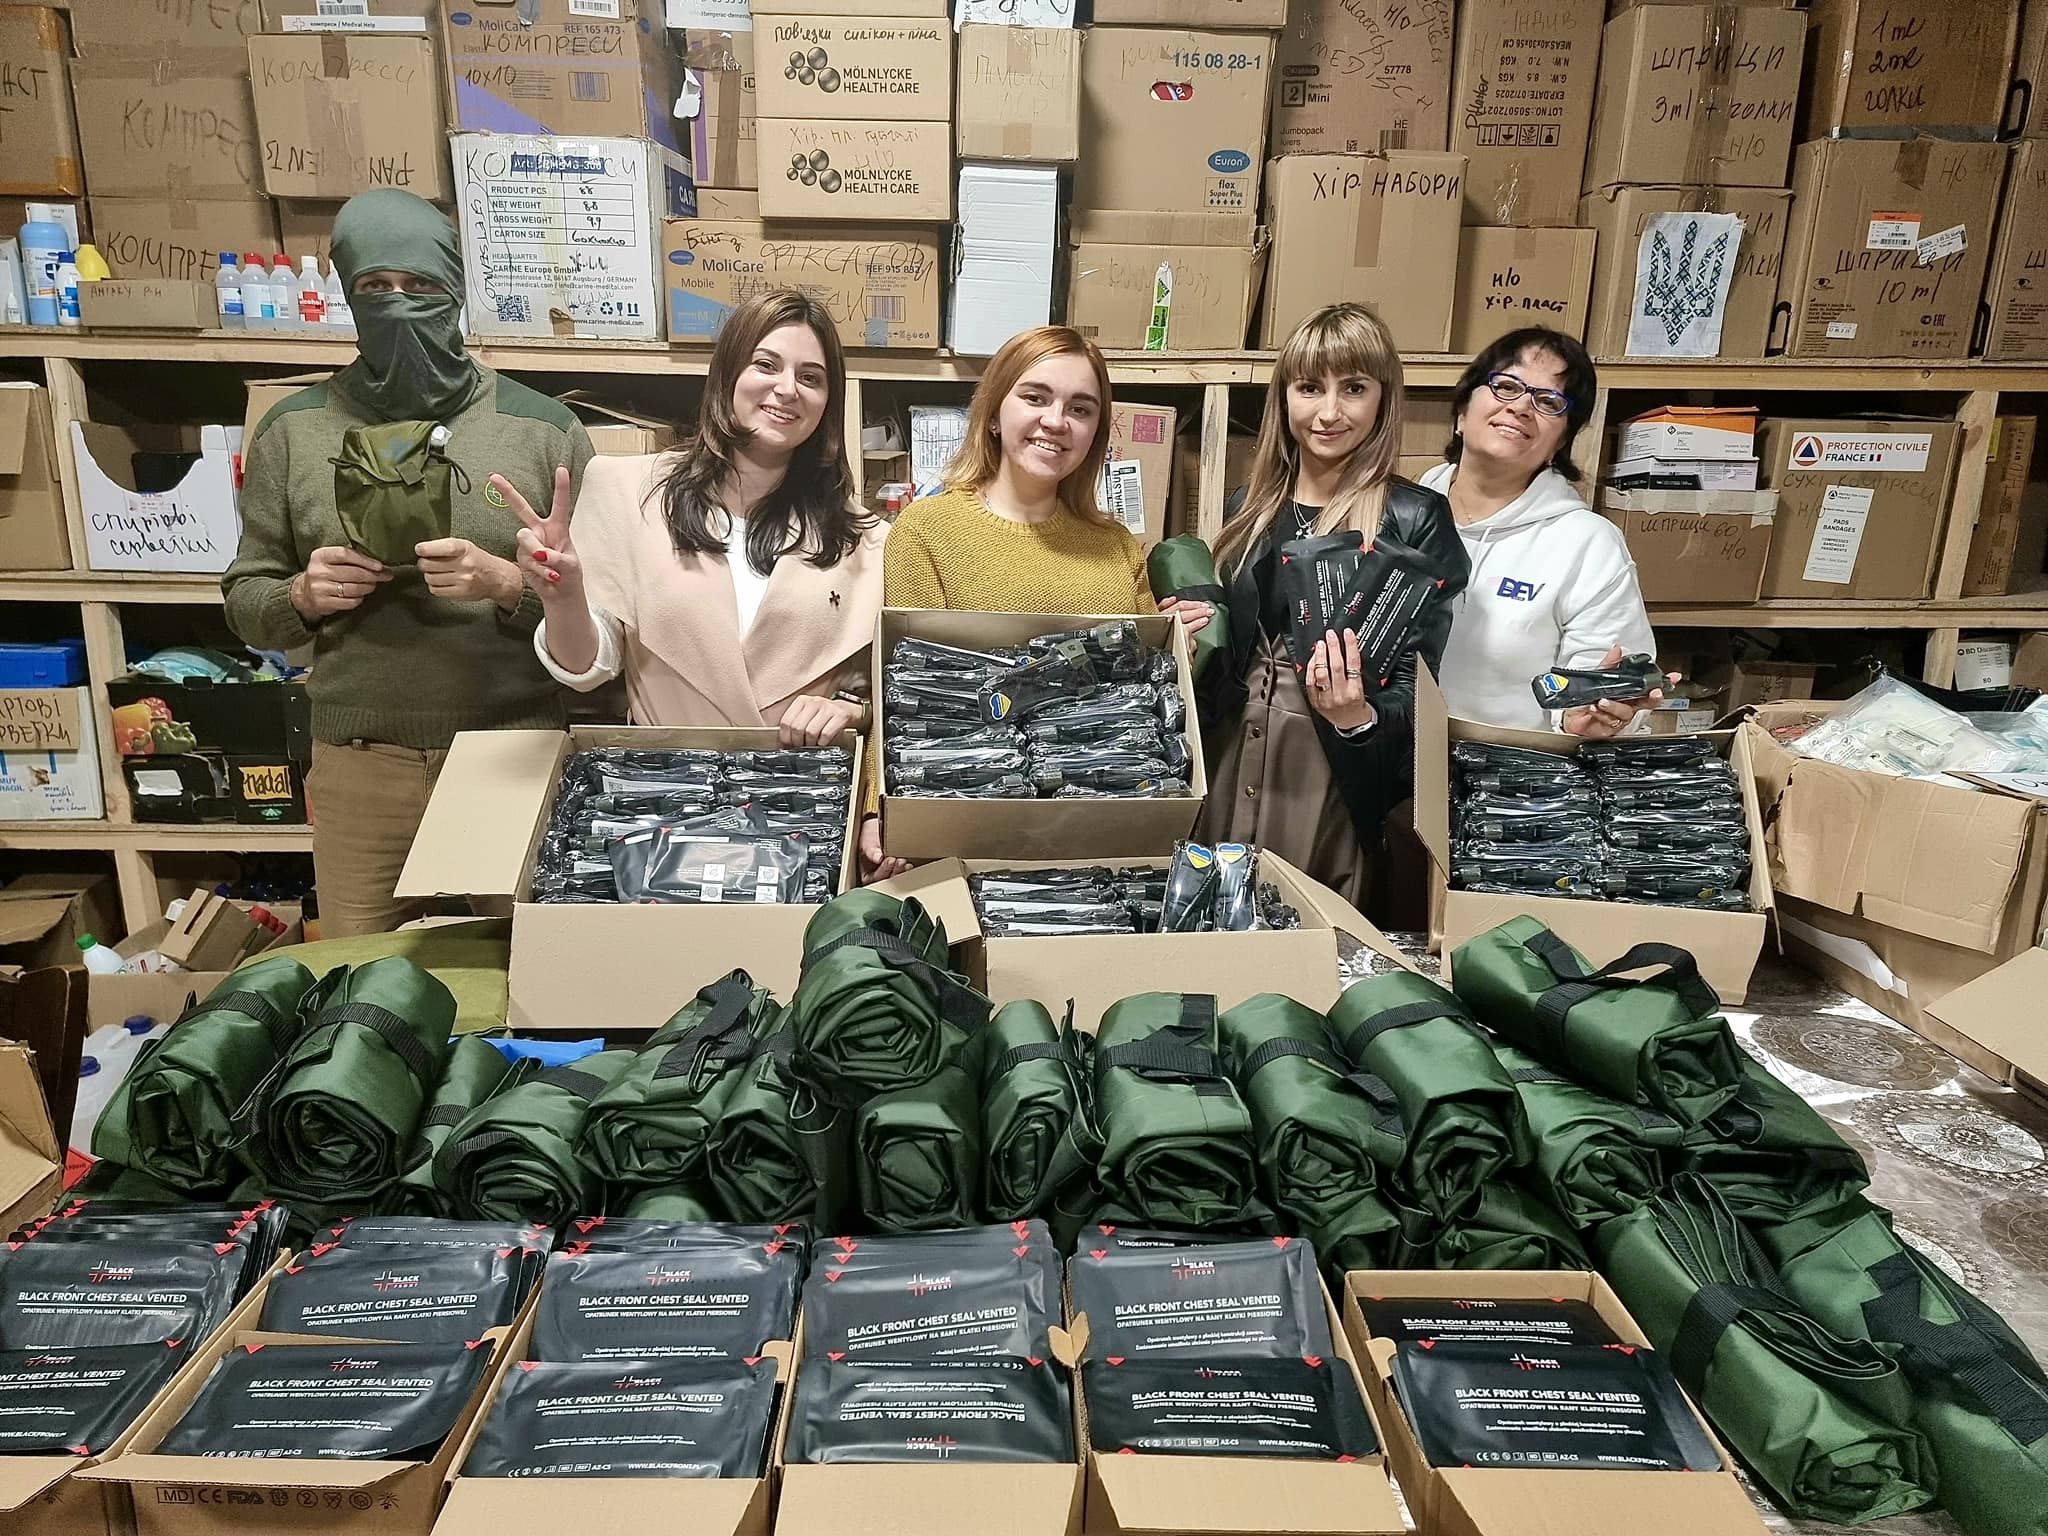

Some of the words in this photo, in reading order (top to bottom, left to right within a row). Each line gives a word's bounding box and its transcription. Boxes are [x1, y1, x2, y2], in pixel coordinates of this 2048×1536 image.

[604, 26, 621, 34] 473
[1175, 52, 1200, 67] 115
[1204, 53, 1223, 69] 08
[1228, 54, 1261, 70] 28-1
[843, 66, 912, 79] MÖLNLYCKE
[1384, 65, 1412, 74] 57778
[843, 83, 887, 94] HEALTH
[890, 83, 919, 94] CARE
[1288, 86, 1299, 101] 2
[1307, 93, 1330, 103] Mini
[1394, 120, 1408, 129] HE
[1280, 126, 1325, 135] Jumbopack
[1214, 155, 1243, 167] Euron
[845, 167, 912, 180] MÖLNLYCKE
[845, 183, 888, 194] HEALTH
[890, 184, 919, 194] CARE
[1218, 179, 1236, 190] flex
[530, 187, 547, 195] PCS
[1209, 189, 1228, 198] Super
[1229, 189, 1243, 198] Plus
[521, 217, 553, 225] WEIGHT
[494, 230, 527, 238] CARTON
[528, 231, 546, 239] SIZE
[493, 265, 523, 273] CARINE
[524, 266, 552, 274] Europe
[553, 266, 578, 274] GmbH
[702, 259, 764, 273] MoliCare
[866, 264, 884, 274] REF
[885, 264, 901, 274] 915
[681, 277, 715, 289] Mobile
[1827, 441, 1893, 451] PROTECTION
[1895, 442, 1929, 451] CIVILE
[1825, 453, 1866, 462] FRANCE
[1823, 524, 1856, 533] BANDAGES
[18, 1292, 50, 1301] BLACK
[52, 1293, 86, 1302] FRONT
[87, 1293, 119, 1302] CHEST
[120, 1293, 144, 1302] SEAL
[147, 1293, 187, 1303] VENTED
[579, 1296, 611, 1306] BLACK
[614, 1296, 647, 1305] FRONT
[650, 1295, 681, 1305] CHEST
[683, 1295, 707, 1304] SEAL
[709, 1294, 749, 1304] VENTED
[302, 1305, 336, 1315] BLACK
[338, 1301, 375, 1312] FRONT
[376, 1299, 408, 1310] CHEST
[410, 1297, 435, 1307] SEAL
[437, 1295, 477, 1305] VENTED
[1115, 1304, 1147, 1315] BLACK
[1149, 1301, 1182, 1312] FRONT
[1183, 1300, 1215, 1310] CHEST
[1216, 1297, 1240, 1307] SEAL
[1242, 1295, 1280, 1306] VENTED
[848, 1322, 880, 1338] BLACK
[882, 1318, 916, 1331] FRONT
[918, 1314, 949, 1327] CHEST
[951, 1311, 976, 1323] SEAL
[977, 1307, 1017, 1320] VENTED
[83, 1370, 126, 1378] VENTED
[250, 1379, 286, 1388] BLACK
[287, 1379, 329, 1387] FRONT
[330, 1379, 360, 1387] CHEST
[361, 1378, 389, 1387] SEAL
[390, 1378, 433, 1386] VENTED
[537, 1396, 573, 1408] BLACK
[575, 1394, 614, 1404] FRONT
[616, 1394, 651, 1403] CHEST
[653, 1393, 679, 1402] SEAL
[680, 1393, 723, 1402] VENTED
[1132, 1392, 1167, 1401] BLACK
[1169, 1391, 1205, 1400] FRONT
[1207, 1391, 1241, 1400] CHEST
[1243, 1392, 1269, 1401] SEAL
[1271, 1393, 1314, 1403] VENTED
[1455, 1389, 1492, 1399] BLACK
[1493, 1389, 1529, 1399] FRONT
[1532, 1390, 1566, 1400] CHEST
[1567, 1392, 1594, 1401] SEAL
[1596, 1392, 1640, 1403] VENTED
[840, 1411, 883, 1421] VENTED
[886, 1411, 912, 1419] SEAL
[914, 1411, 949, 1419] CHEST
[990, 1411, 1025, 1422] BLACK
[163, 1489, 188, 1501] MD
